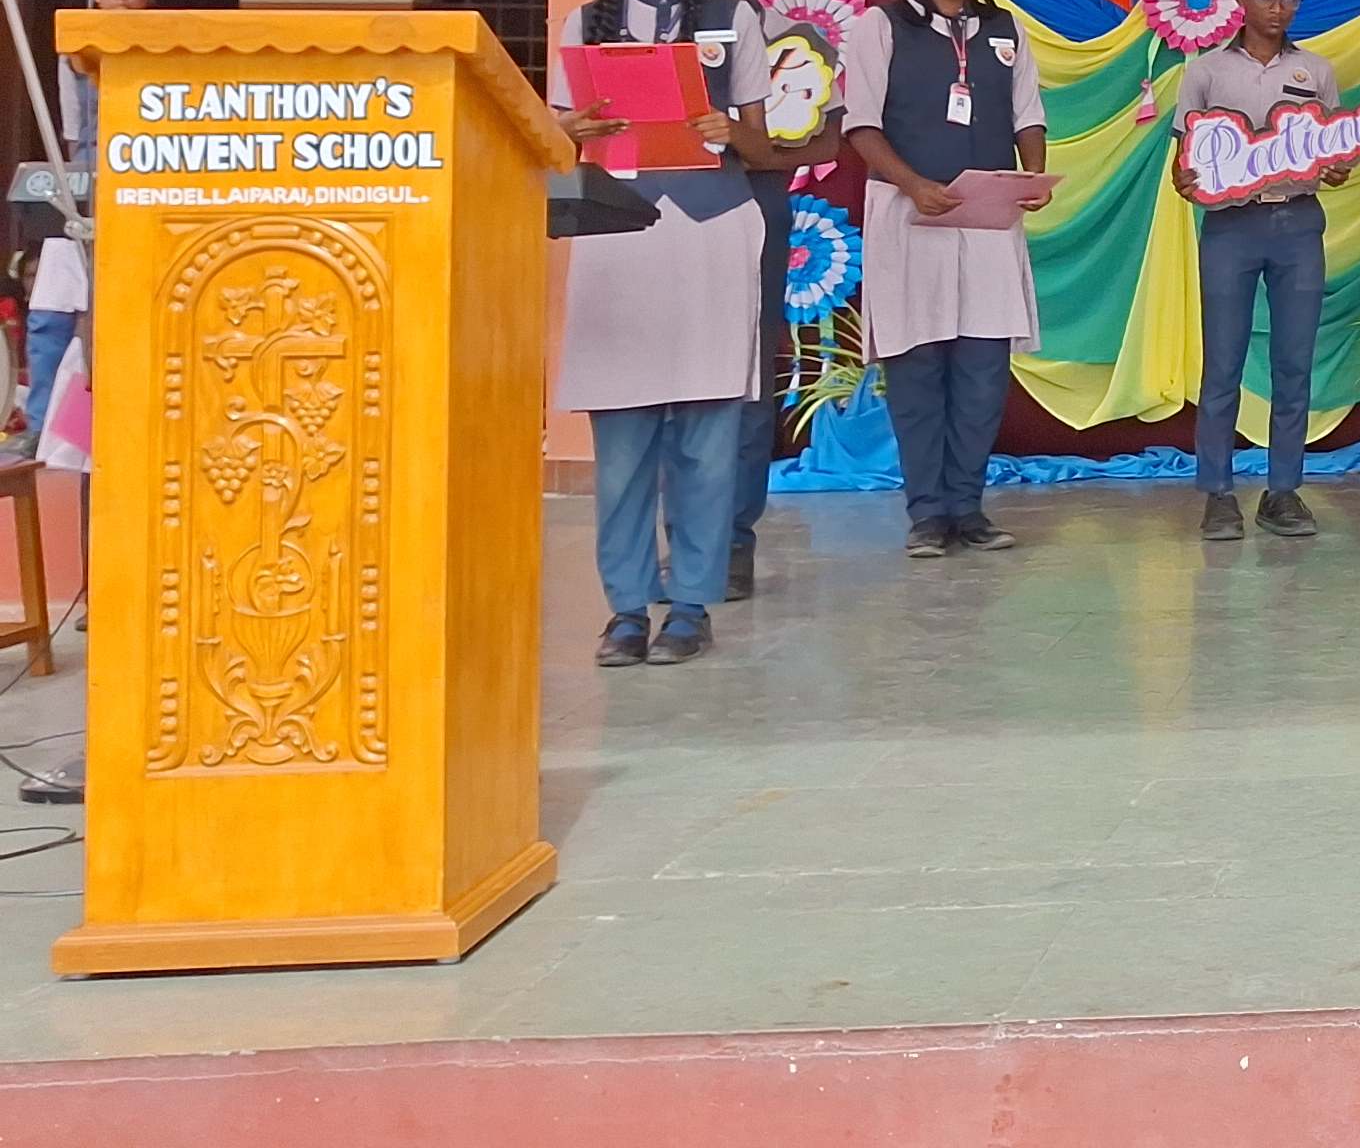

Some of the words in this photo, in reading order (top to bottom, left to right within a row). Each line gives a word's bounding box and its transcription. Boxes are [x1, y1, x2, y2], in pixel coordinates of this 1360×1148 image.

[139, 77, 414, 122] ST.ANTHONY'S
[108, 133, 283, 173] CONVENT
[292, 131, 444, 170] SCHOOL
